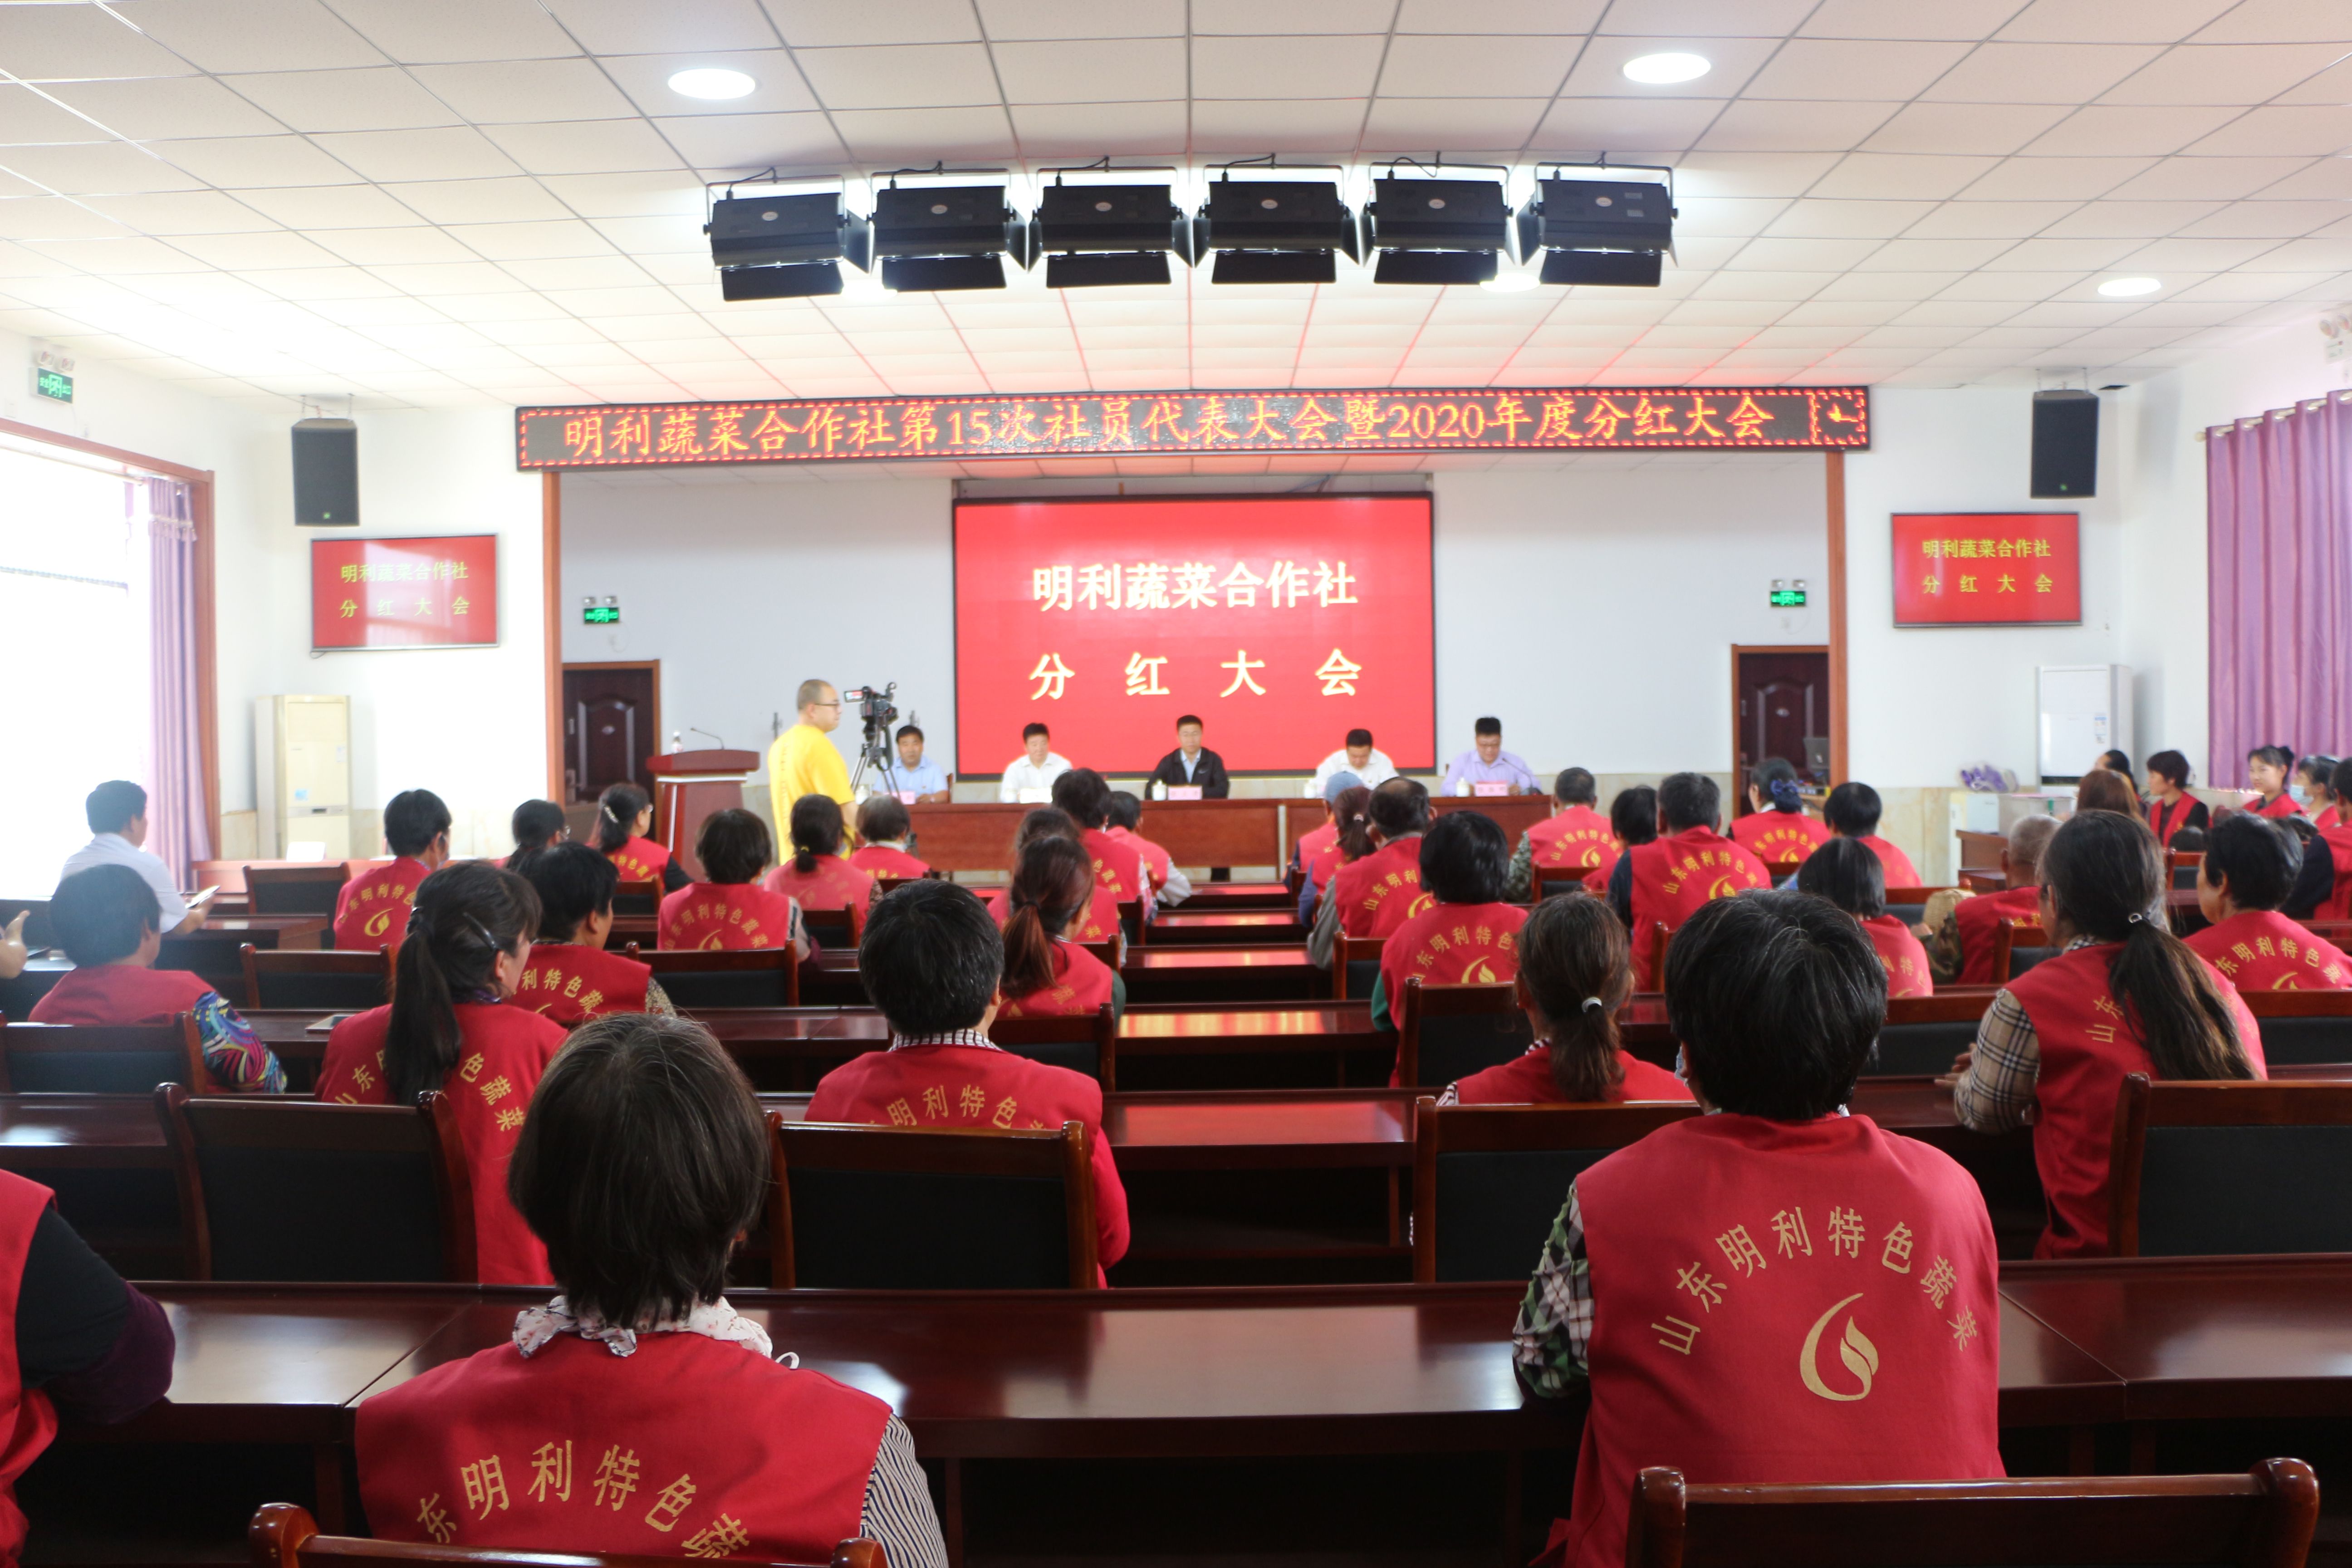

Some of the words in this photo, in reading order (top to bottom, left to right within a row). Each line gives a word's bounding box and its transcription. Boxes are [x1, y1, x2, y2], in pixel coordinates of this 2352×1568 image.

[565, 396, 1774, 456] 明利蔬菜合作社第15次社员代表大会暨2020年度分红大会
[341, 562, 468, 583] 明利蔬菜合作社
[1922, 539, 2051, 558] 明利蔬菜合作社
[1033, 561, 1358, 611] 明利蔬菜合作社
[1412, 926, 1519, 983] 东明利特色
[513, 968, 610, 1016] 利特色蔬
[867, 1084, 1047, 1130] 明利特色
[1651, 1206, 1977, 1355] 山东明利特色蔬菜
